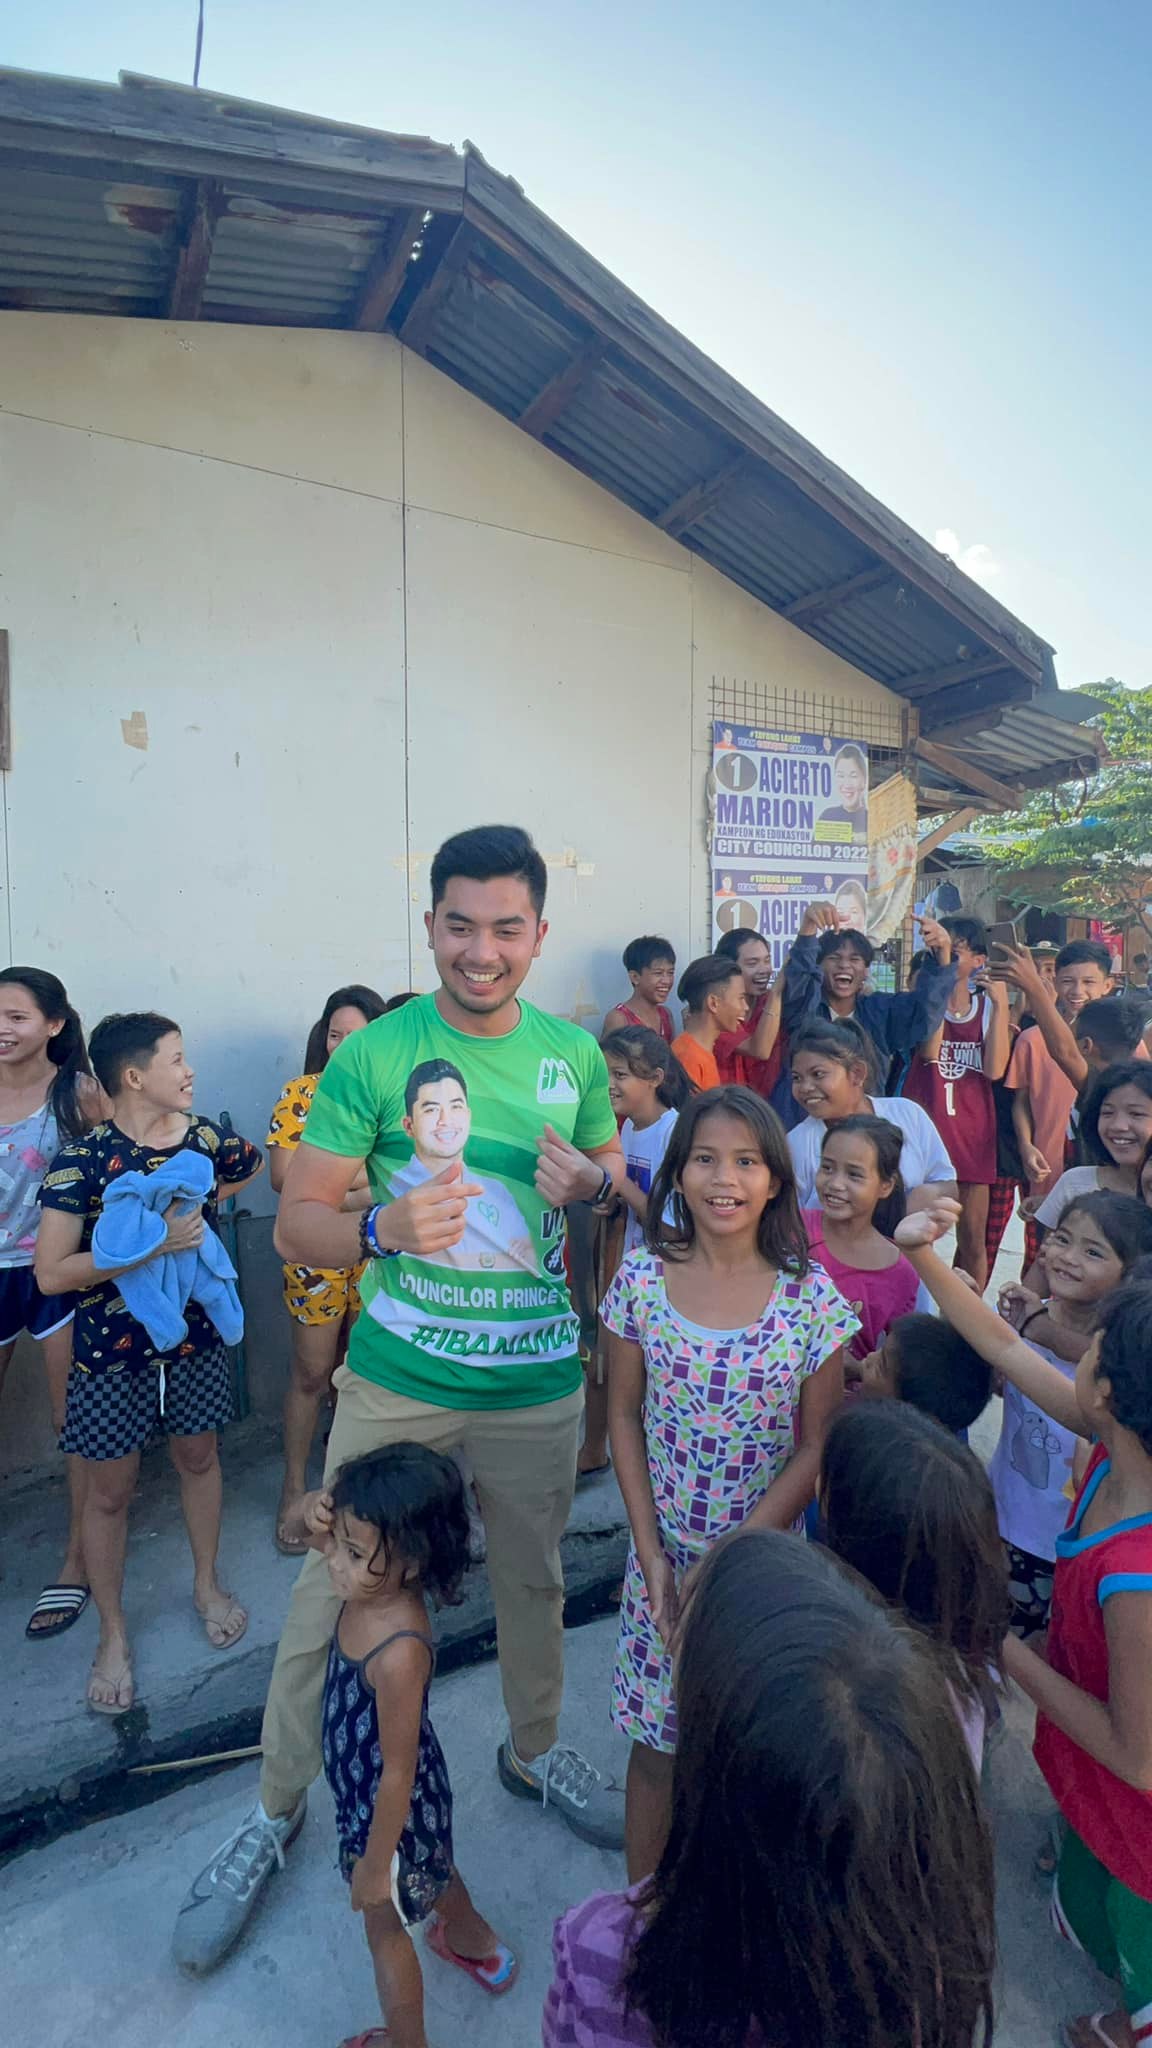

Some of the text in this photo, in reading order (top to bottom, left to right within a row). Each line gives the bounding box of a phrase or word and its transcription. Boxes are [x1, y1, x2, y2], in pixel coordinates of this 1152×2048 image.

[731, 756, 742, 787] 1
[759, 756, 832, 798] ACIERTO
[717, 793, 814, 830] MARION
[717, 826, 752, 838] KAMPEON
[755, 828, 766, 839] NG
[767, 829, 810, 841] EDUKASYON
[717, 839, 869, 859] CITY COUNCILOR 2022
[730, 902, 741, 930] 1
[944, 1082, 956, 1116] 1
[502, 1286, 563, 1309] PRINCE
